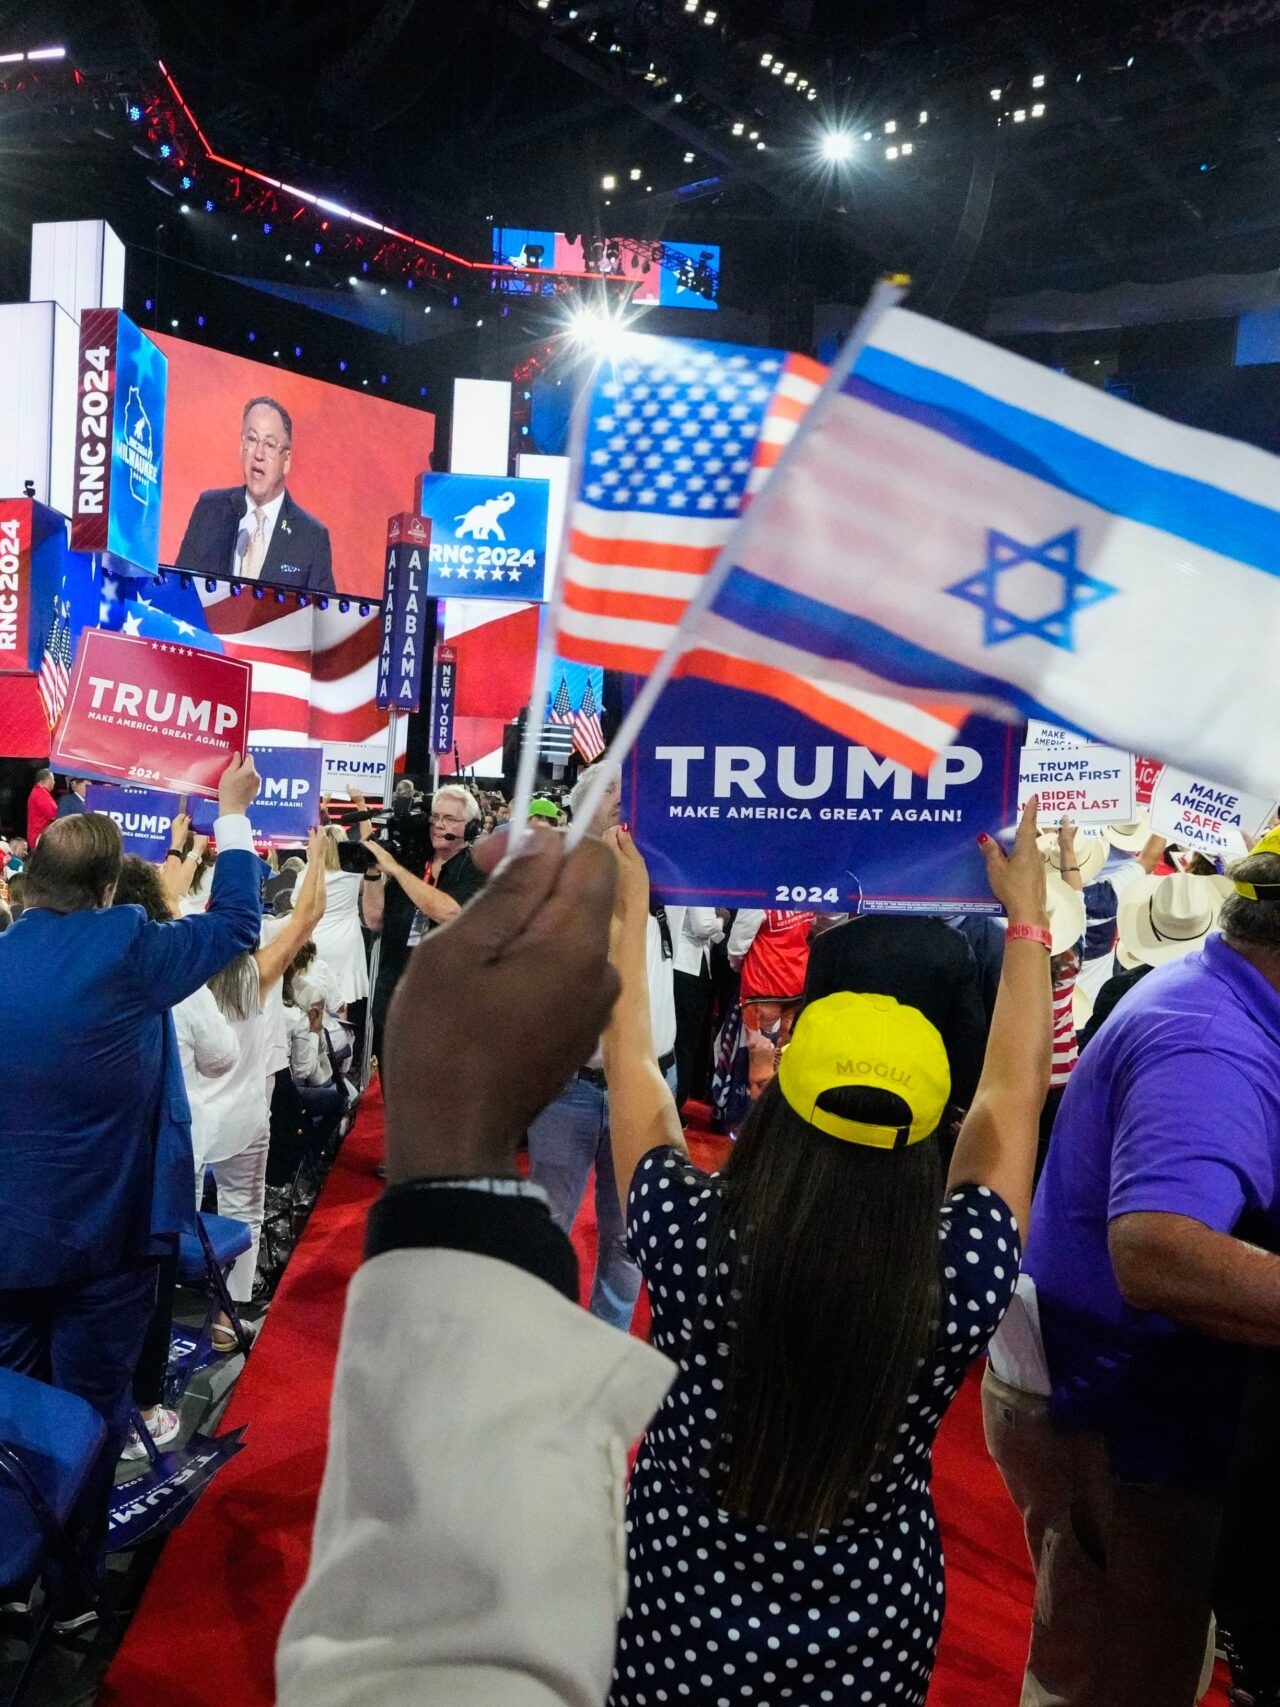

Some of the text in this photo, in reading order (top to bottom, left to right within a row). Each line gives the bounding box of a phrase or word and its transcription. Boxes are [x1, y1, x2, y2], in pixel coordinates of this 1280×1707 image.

[379, 549, 397, 698] ALABAMA
[399, 549, 422, 699] ALABAMA
[440, 664, 451, 698] NEW
[88, 676, 239, 735] TRUMP
[87, 711, 230, 749] MAKE AMERICA GREAT AGAIN!
[438, 703, 449, 749] YORK
[1041, 729, 1066, 740] MAKE
[127, 766, 161, 781] 2024
[325, 759, 387, 774] TRUMP
[655, 745, 983, 800] TRUMP
[1019, 769, 1121, 783] MERICA FIRST
[1038, 760, 1089, 771] TRUMP
[1041, 790, 1086, 801] BIDEN
[1082, 799, 1120, 810] LAST
[1189, 782, 1239, 809] MAKE
[669, 806, 962, 822] MAKE AMERICA GREAT AGAIN!
[1170, 792, 1241, 827] AMERICA
[1182, 810, 1222, 833] SAFE
[1173, 821, 1228, 847] AGAIN!
[775, 885, 839, 903] 2024
[835, 1059, 915, 1091] MOGUL
[108, 1451, 219, 1531] TRUM
